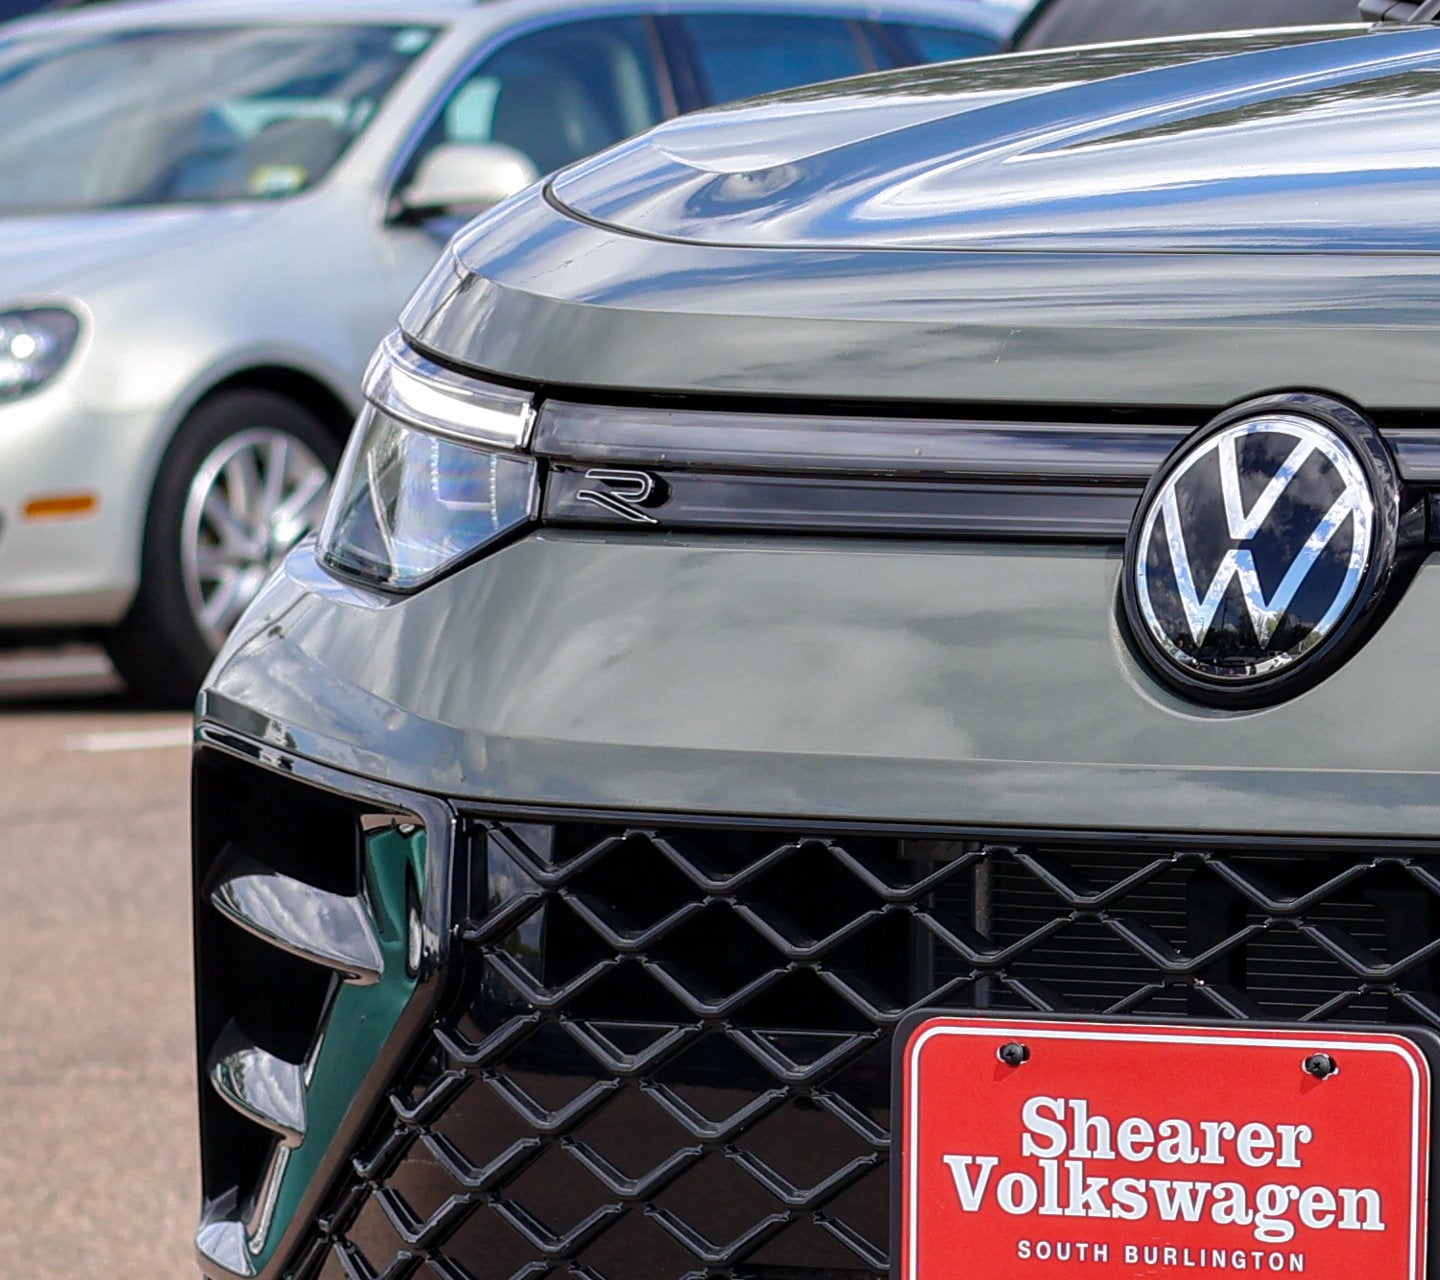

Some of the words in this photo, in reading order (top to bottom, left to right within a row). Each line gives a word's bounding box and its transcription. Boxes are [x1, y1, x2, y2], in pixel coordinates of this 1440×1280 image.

[576, 468, 660, 524] R
[1152, 426, 1360, 652] VW
[1021, 1095, 1312, 1168] Shearer
[942, 1153, 1386, 1244] Volkswagen
[1016, 1239, 1109, 1263] SOUTH
[1124, 1243, 1305, 1272] BURLINGTON
